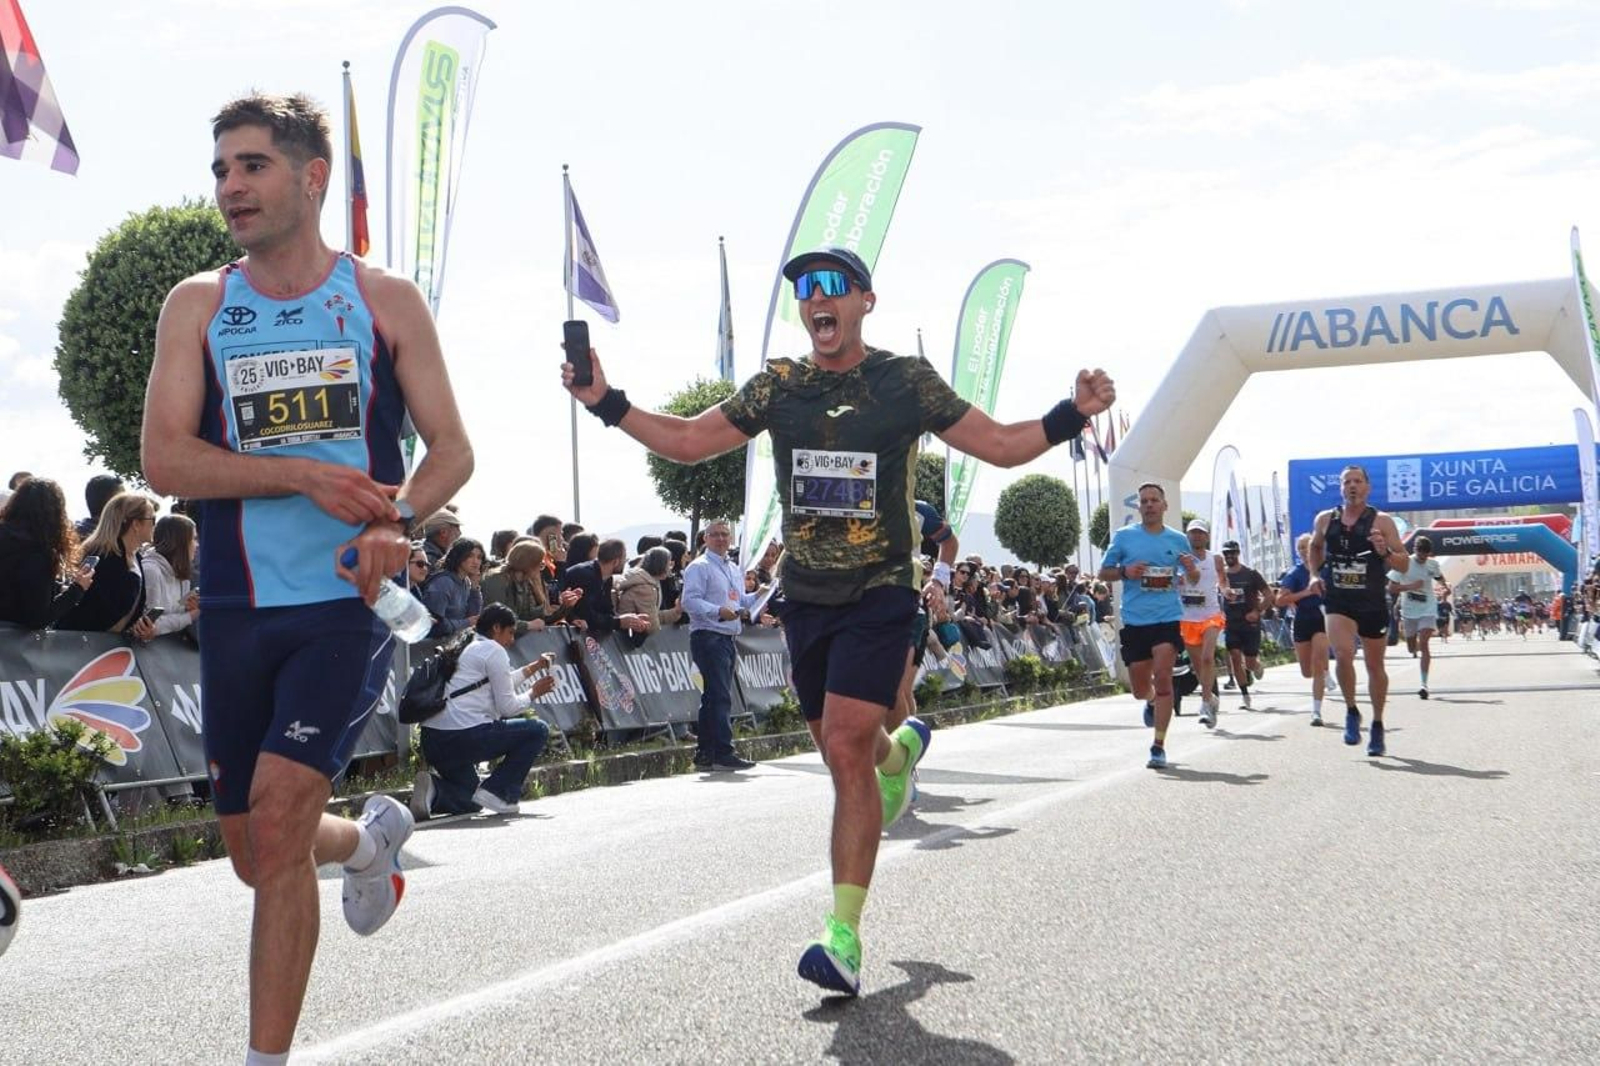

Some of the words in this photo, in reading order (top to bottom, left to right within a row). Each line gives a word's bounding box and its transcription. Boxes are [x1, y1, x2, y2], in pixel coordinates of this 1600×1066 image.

[820, 190, 850, 246] oder
[972, 307, 989, 353] poder
[968, 353, 984, 373] El
[240, 367, 257, 385] 25
[268, 388, 329, 424] 511
[259, 420, 333, 436] COCODRILOSUAREZ
[1430, 459, 1507, 477] XUNTA
[1430, 481, 1457, 498] DE
[1465, 474, 1556, 495] GALICIA
[1442, 533, 1519, 546] POWERADE
[1491, 551, 1545, 566] YAMAHA
